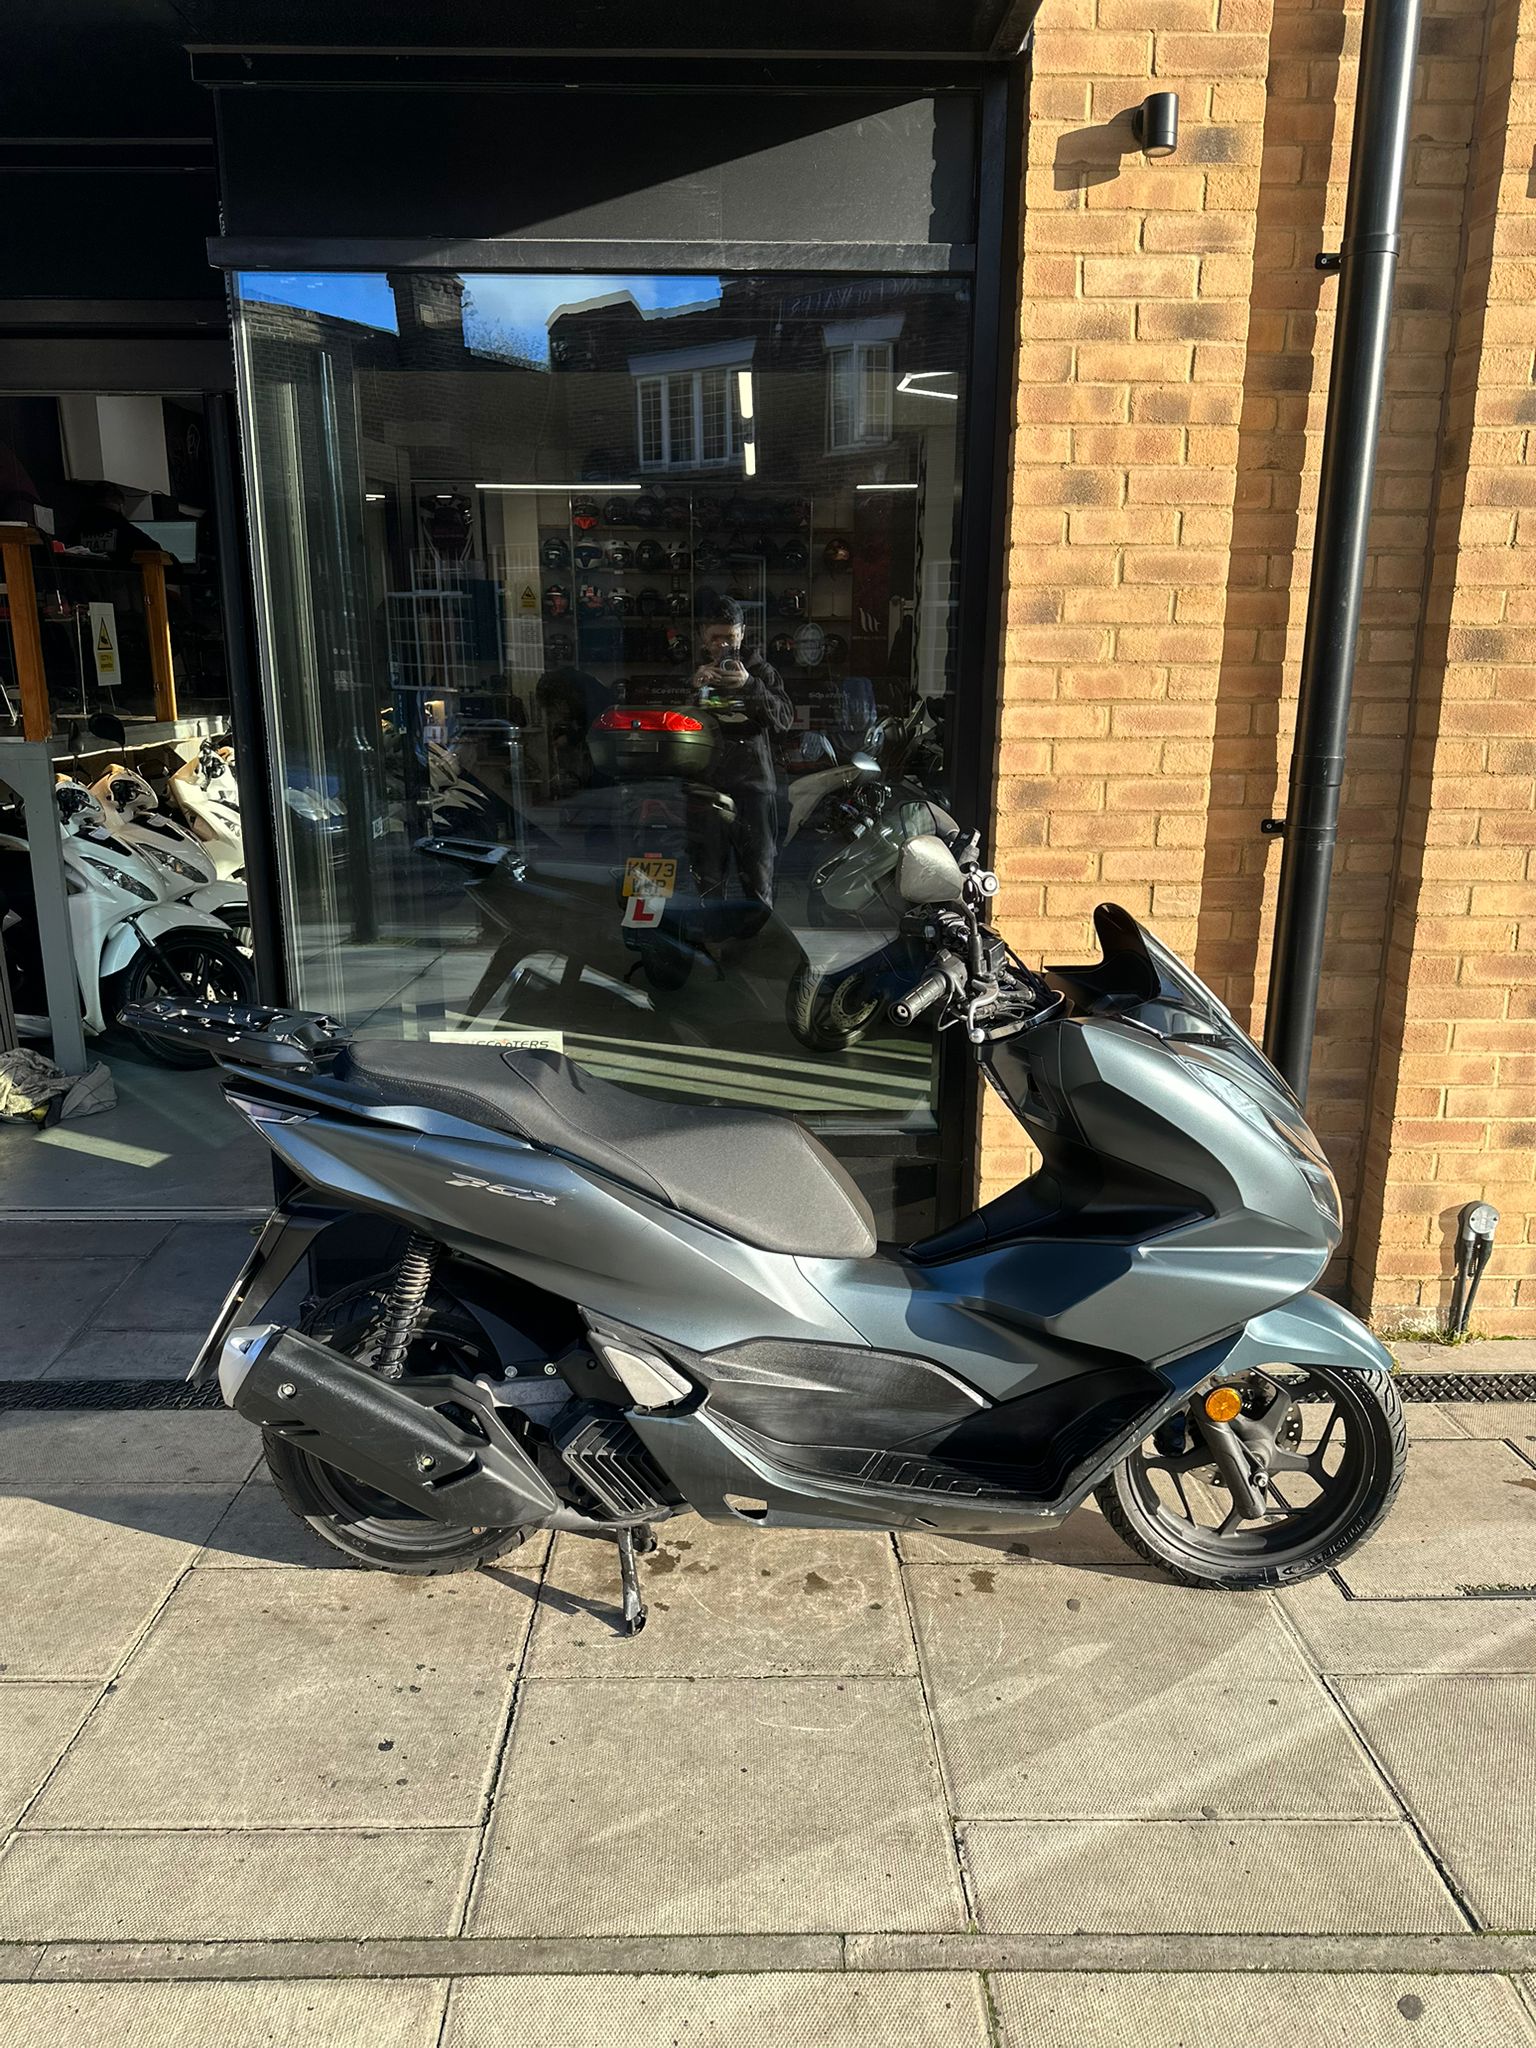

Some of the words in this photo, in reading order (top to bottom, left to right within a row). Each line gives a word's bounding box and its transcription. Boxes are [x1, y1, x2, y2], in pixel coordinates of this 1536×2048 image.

[627, 862, 675, 877] KM73
[632, 899, 655, 921] L
[445, 1171, 558, 1206] PCX
